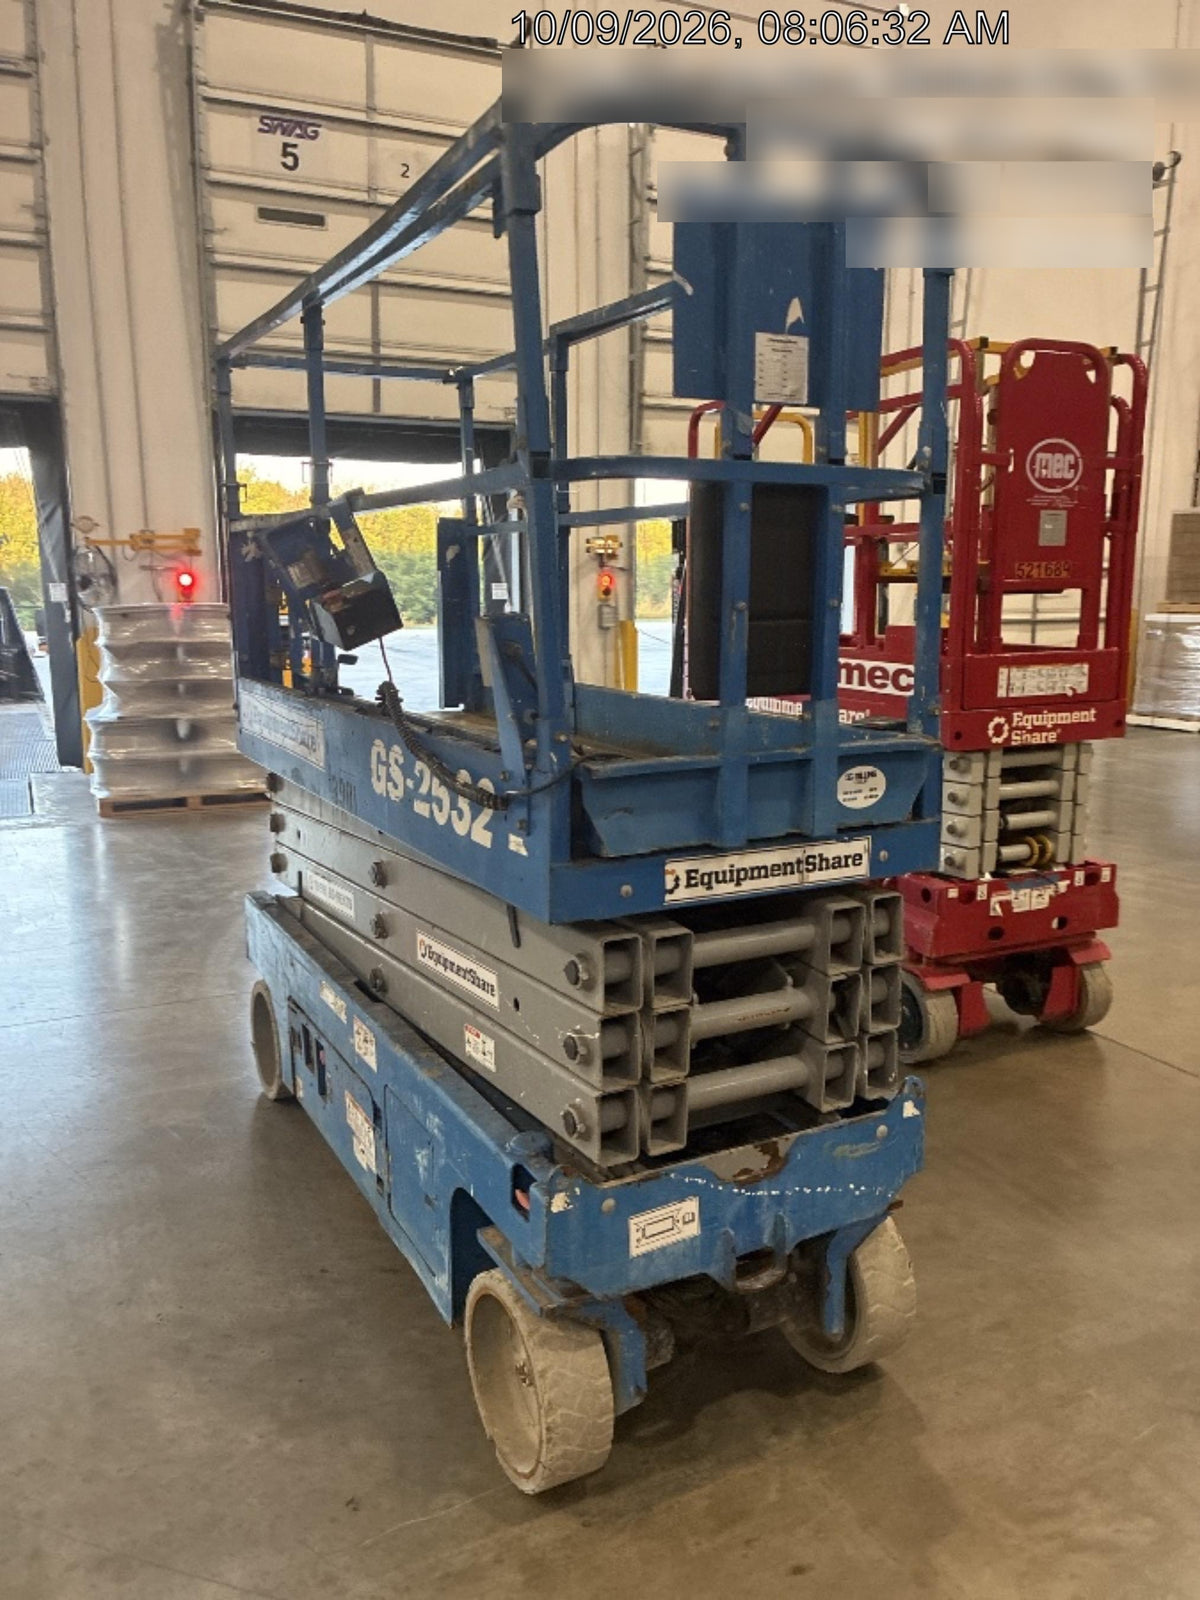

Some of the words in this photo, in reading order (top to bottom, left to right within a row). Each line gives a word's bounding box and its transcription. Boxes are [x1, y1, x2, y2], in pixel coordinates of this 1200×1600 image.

[280, 141, 300, 172] 5
[400, 162, 411, 179] 2
[1011, 707, 1097, 730] Equipment
[1010, 729, 1058, 746] Share
[684, 851, 864, 892] EquipmentShare
